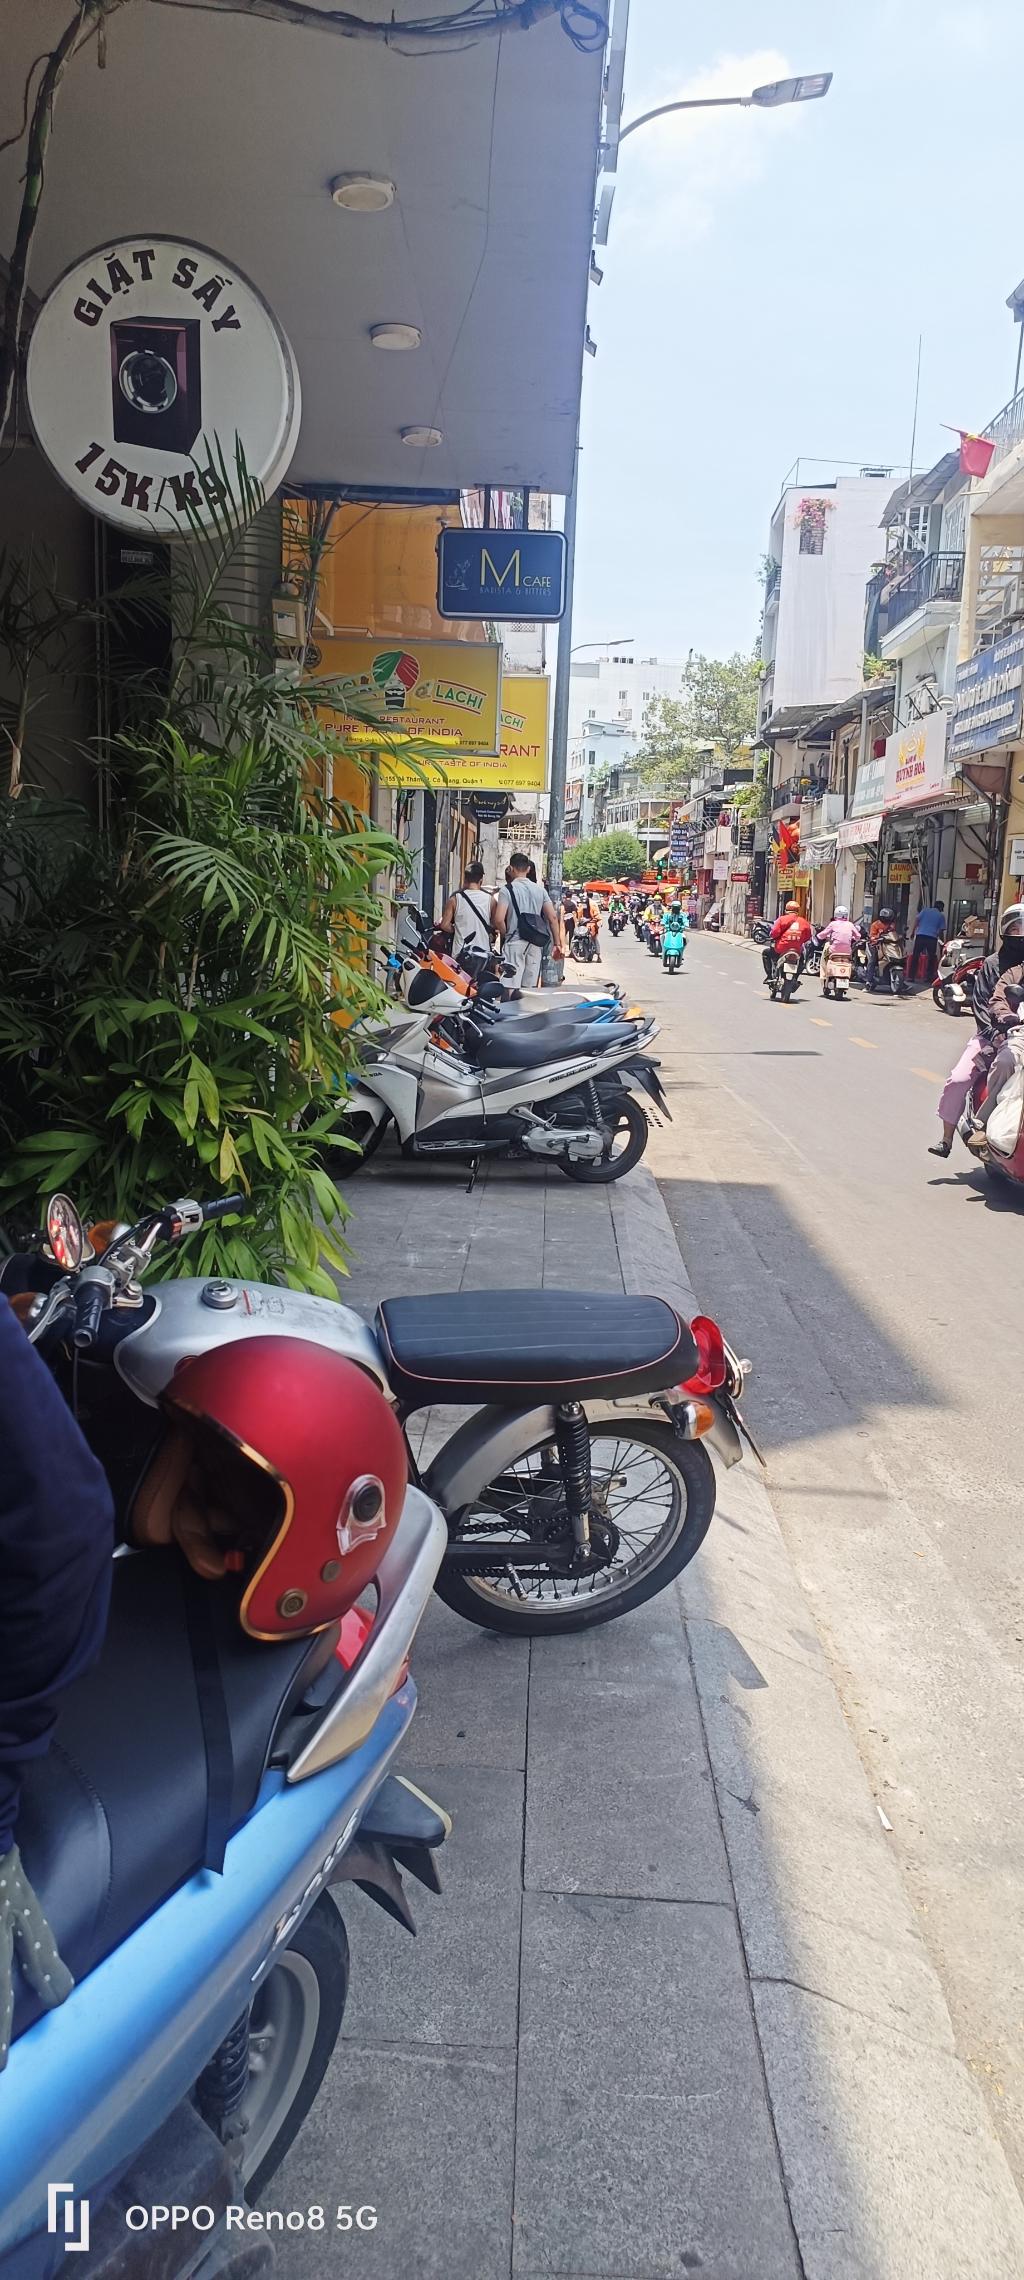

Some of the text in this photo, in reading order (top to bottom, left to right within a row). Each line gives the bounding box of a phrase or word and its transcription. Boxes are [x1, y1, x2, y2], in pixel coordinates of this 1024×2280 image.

[73, 249, 242, 332] GIẶT SẤY
[480, 548, 551, 588] M CAFE
[436, 684, 484, 710] LACHI
[325, 723, 359, 733] PURE
[408, 727, 425, 737] OF
[428, 727, 463, 737] INDIA
[499, 743, 541, 757] RANT
